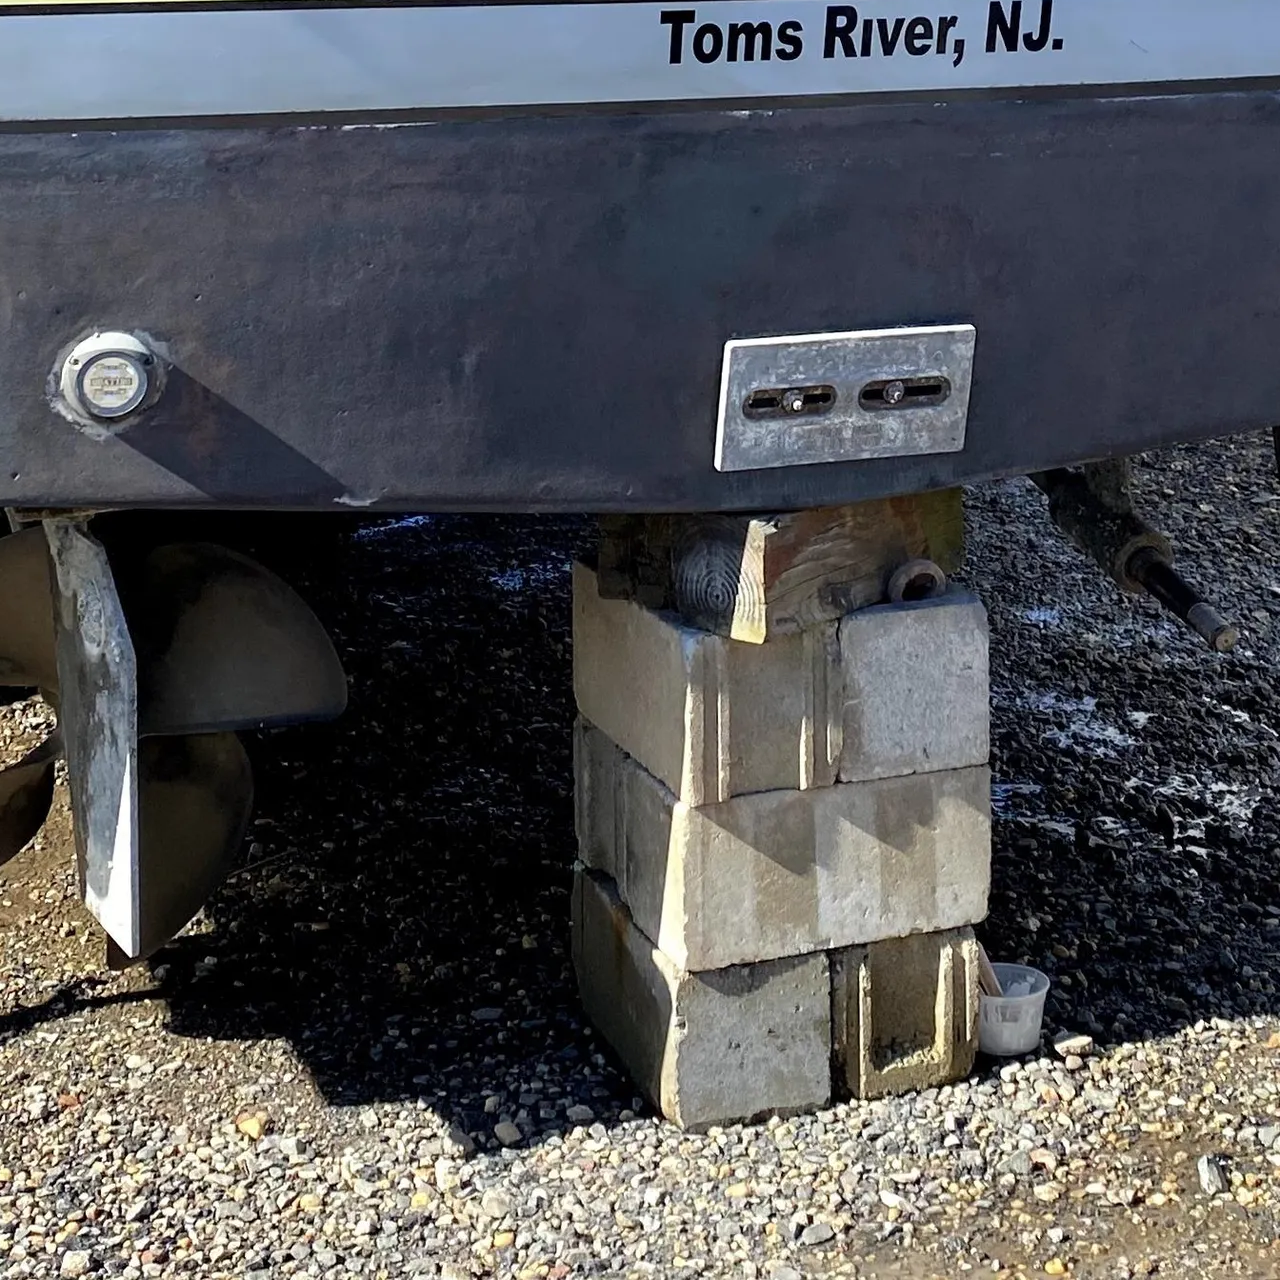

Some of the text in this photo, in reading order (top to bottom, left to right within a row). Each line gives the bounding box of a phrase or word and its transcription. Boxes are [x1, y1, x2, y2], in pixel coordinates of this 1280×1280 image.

[660, 0, 1064, 67] Toms River, NJ.
